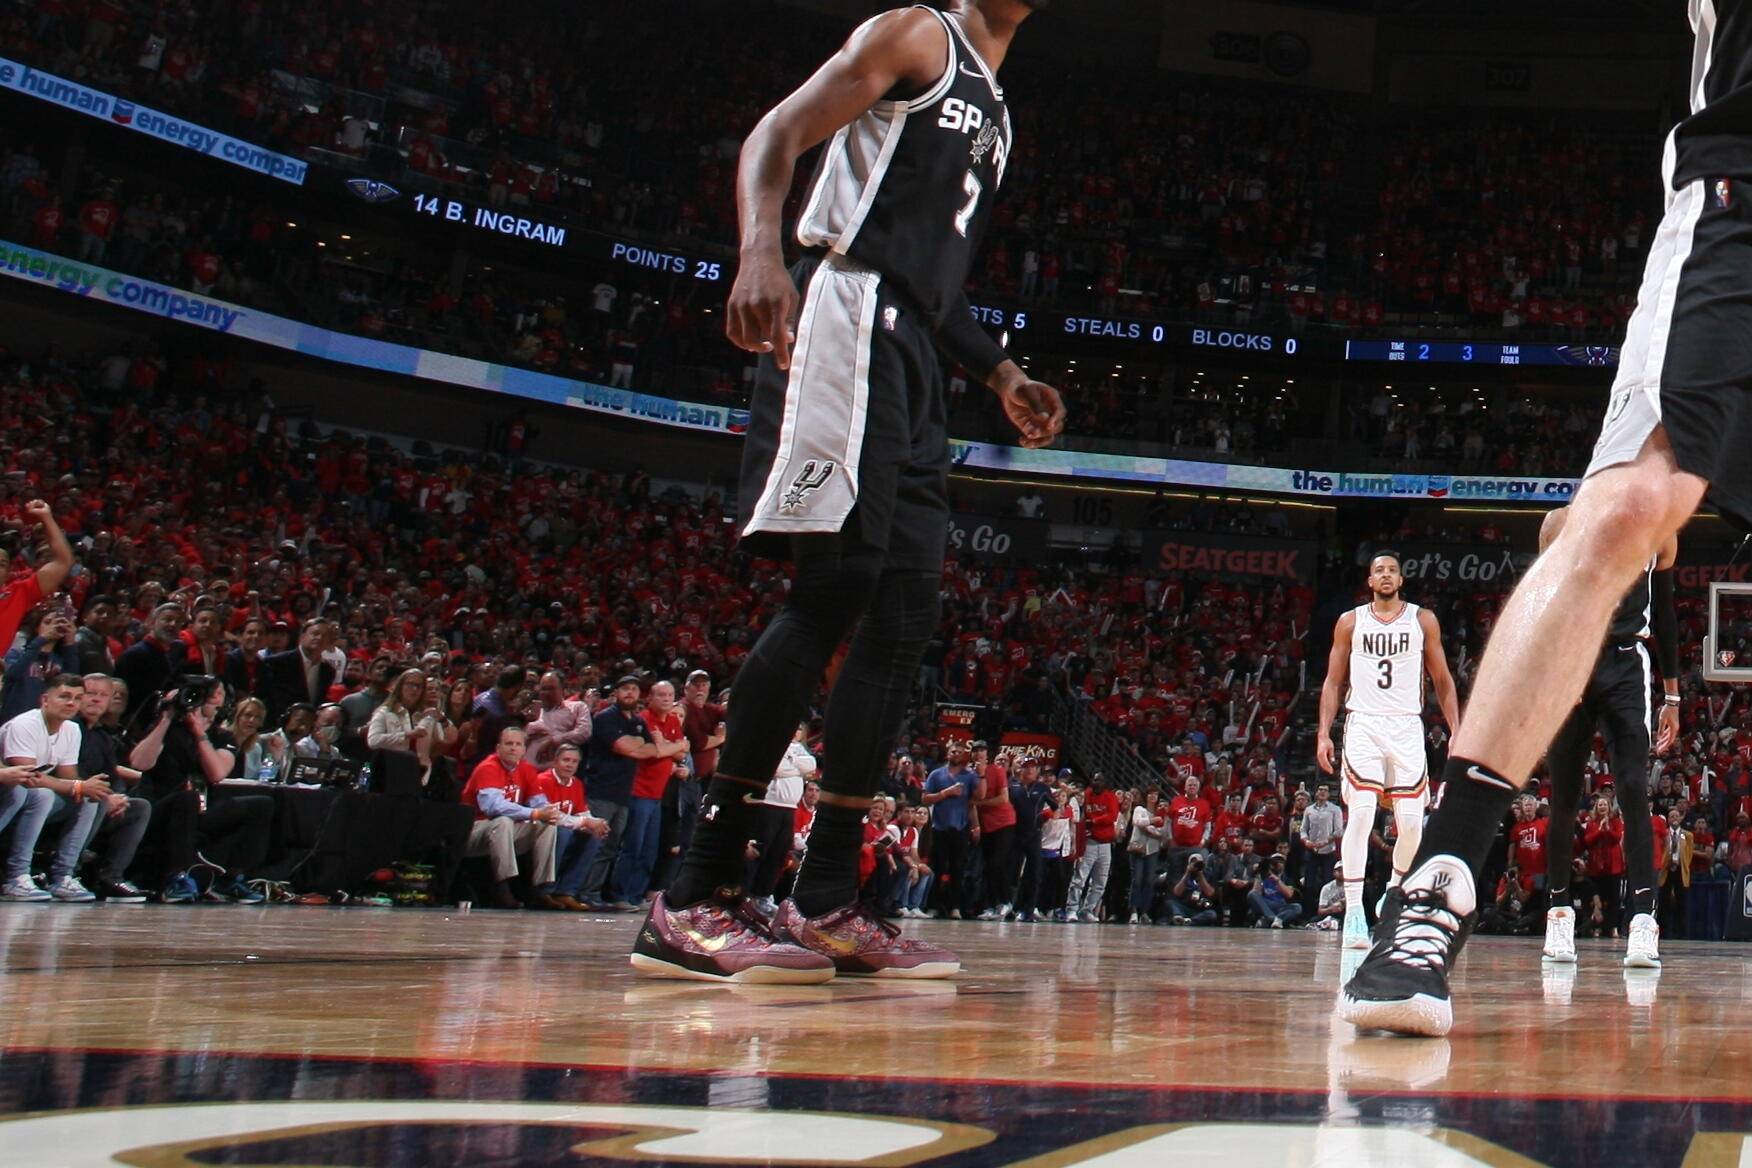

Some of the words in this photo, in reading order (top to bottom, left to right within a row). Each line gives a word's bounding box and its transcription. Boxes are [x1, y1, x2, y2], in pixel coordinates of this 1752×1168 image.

[19, 65, 110, 115] human
[136, 109, 219, 154] energy
[954, 169, 983, 238] 7
[413, 194, 438, 215] 14
[445, 201, 467, 223] B.
[475, 208, 566, 246] INGRAM
[612, 242, 687, 274] POINTS
[694, 261, 721, 281] 25
[105, 277, 239, 332] company
[1013, 313, 1027, 329] 5
[1064, 317, 1141, 339] STEALS
[1152, 326, 1165, 342] 0
[1192, 329, 1272, 351] BLOCKS
[1285, 338, 1297, 354] 0
[1418, 344, 1430, 361] 2
[1462, 345, 1473, 361] 3
[630, 393, 722, 427] human
[1292, 471, 1333, 492] the
[1339, 472, 1424, 494] human
[1452, 479, 1538, 501] energy
[972, 524, 1011, 554] Go
[1159, 543, 1300, 579] SEATGEEK
[1402, 552, 1451, 580] et's
[1458, 553, 1496, 581] Go
[1363, 633, 1410, 657] NOLA
[1377, 659, 1393, 689] 3
